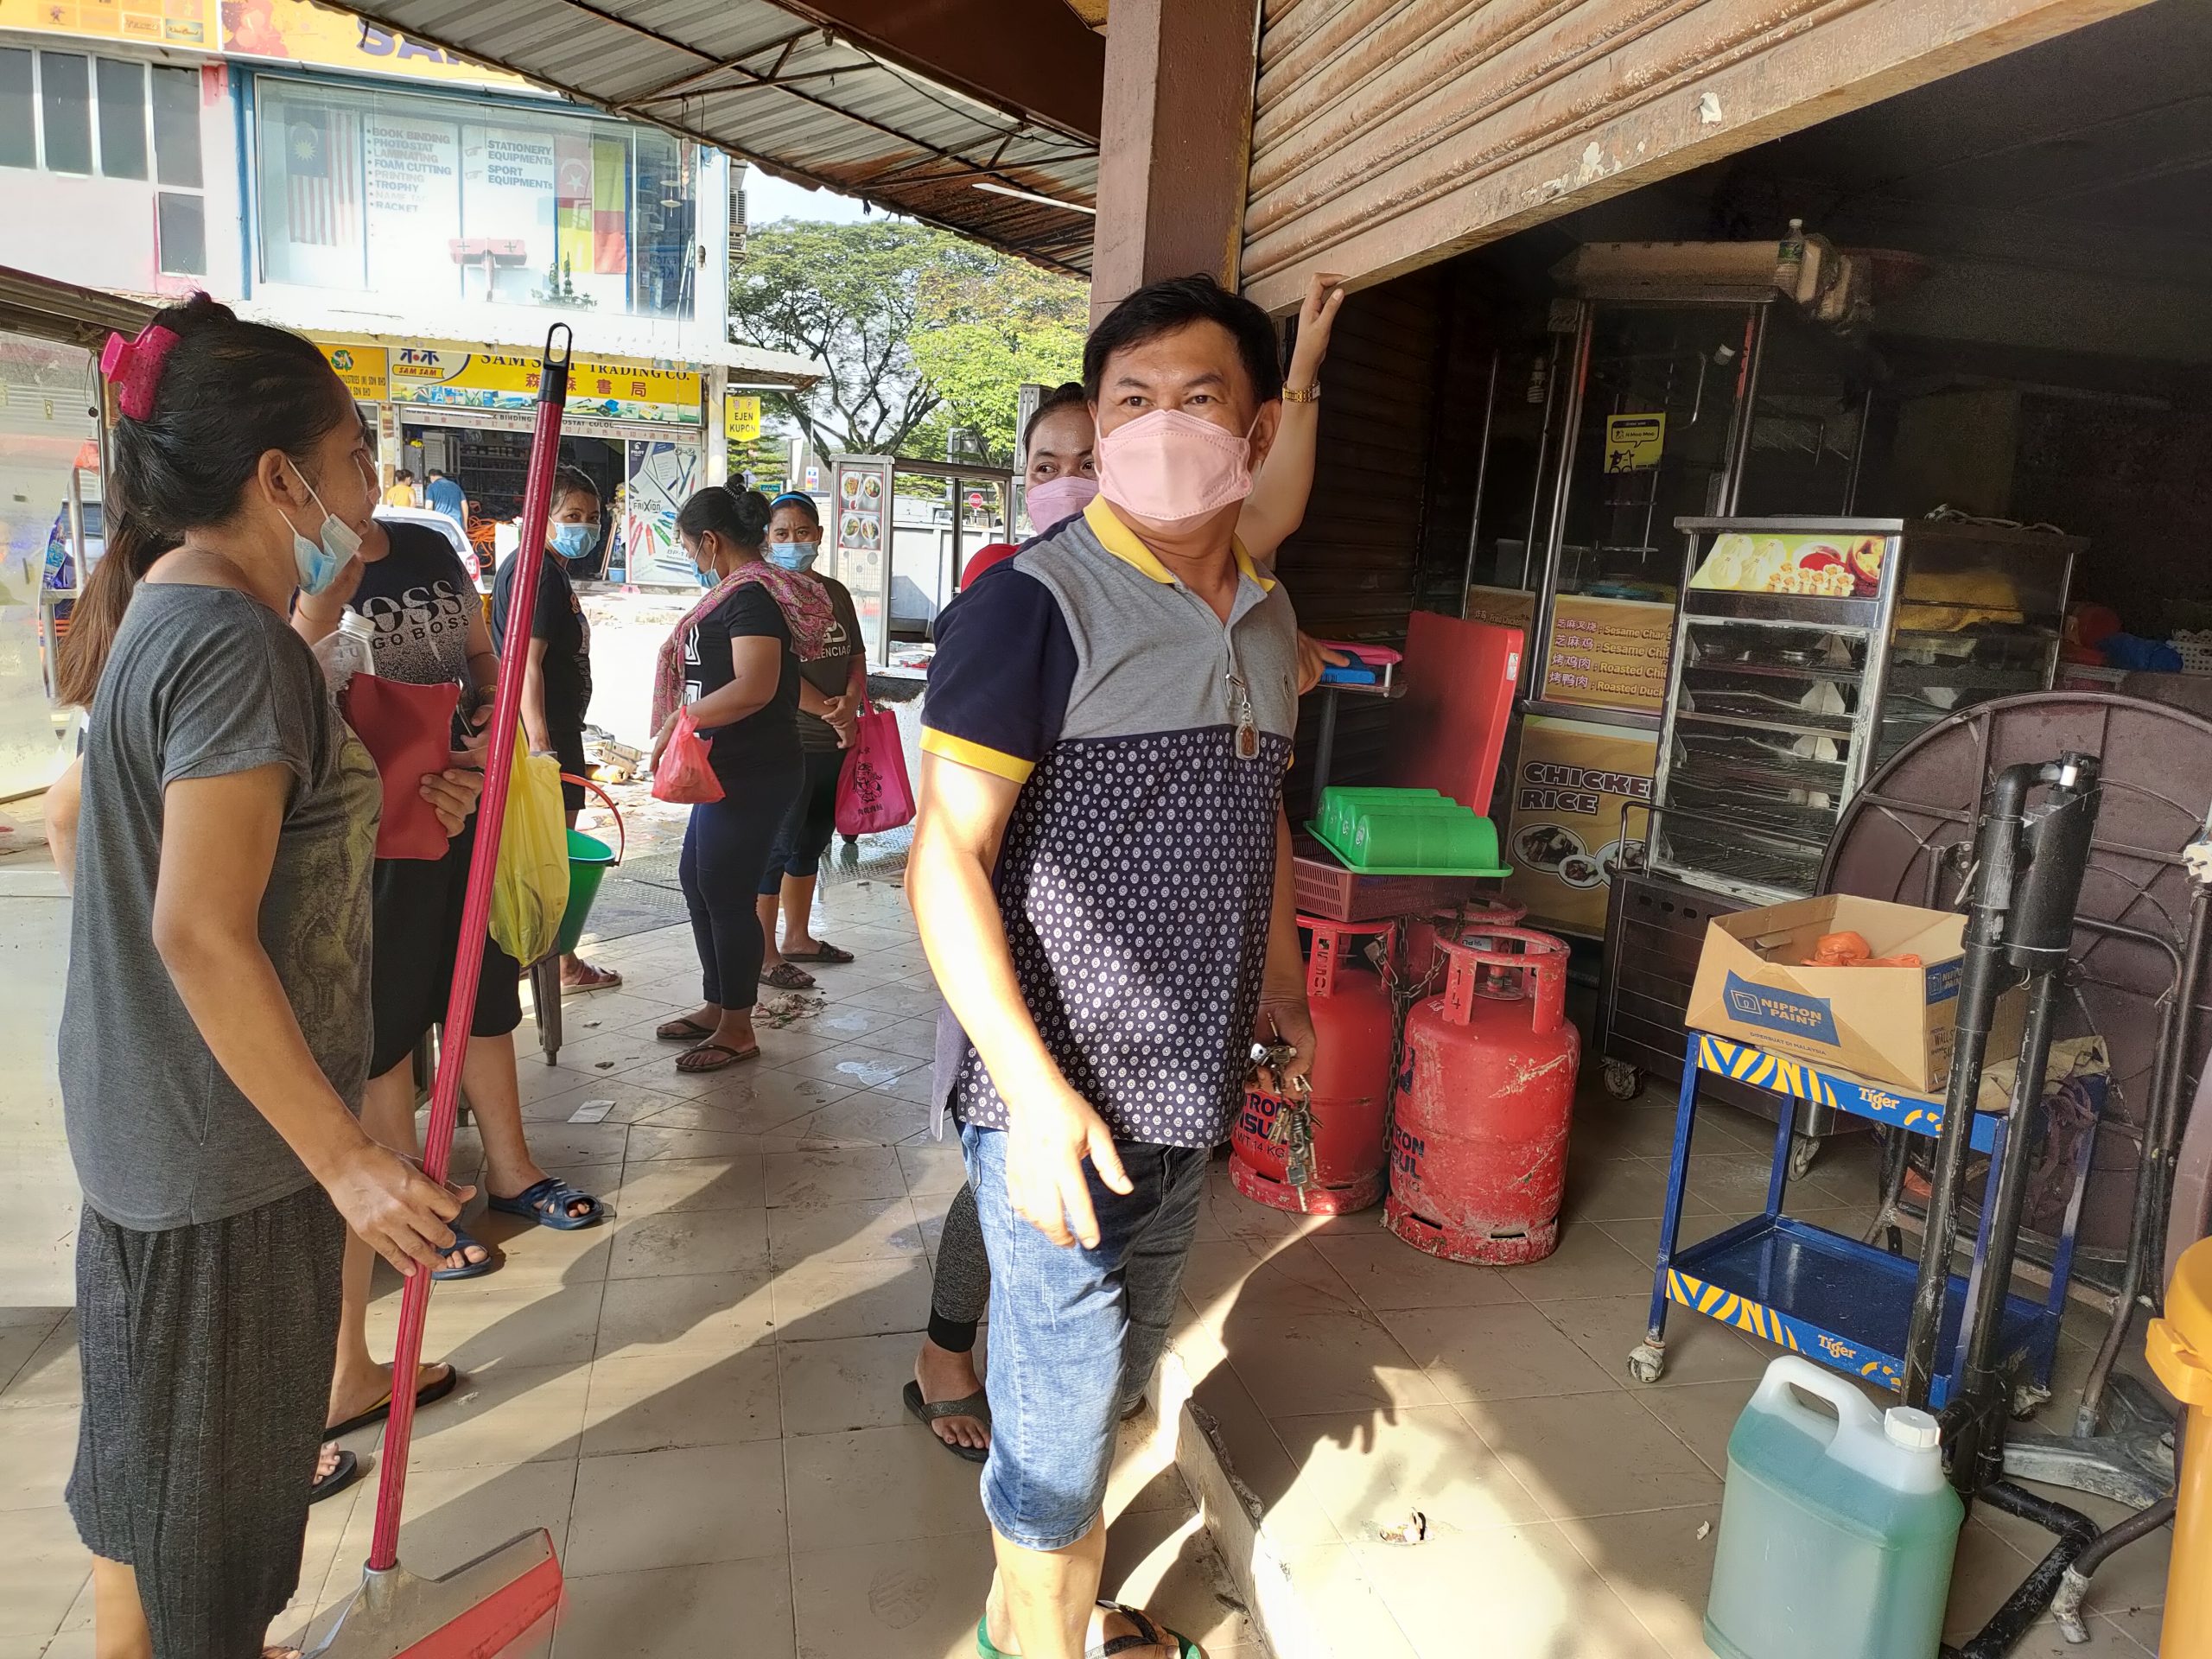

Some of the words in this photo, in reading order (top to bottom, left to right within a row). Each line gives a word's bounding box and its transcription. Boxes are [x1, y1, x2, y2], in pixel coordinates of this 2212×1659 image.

[372, 128, 404, 139] BOOK
[406, 130, 450, 144] BINDING
[373, 137, 434, 153] PHOTOSTAT
[487, 140, 551, 156] STATIONERY
[373, 148, 438, 164] LAMINATING
[374, 158, 404, 171] FOAM
[408, 162, 452, 175] CUTTING
[487, 164, 523, 176] SPORT
[374, 170, 424, 183] PRINTING
[375, 181, 419, 193] TROPHY
[376, 200, 418, 213] RACKET
[665, 371, 690, 381] CO.
[734, 412, 753, 421] EJEN
[729, 424, 756, 433] KUPON
[343, 581, 463, 632] OSS
[412, 614, 469, 640] BOSS
[1605, 626, 1640, 638] Sesame
[1643, 629, 1664, 640] Char
[1555, 635, 1593, 650] 芝麻鸡
[1603, 643, 1645, 656] Sesame
[1551, 653, 1591, 670] 烤鸡肉
[1600, 662, 1643, 676] Roasted
[1549, 671, 1589, 689] 烤鸭肉
[1598, 681, 1637, 695] Roasted
[1523, 761, 1653, 800] CHICKE
[1519, 788, 1599, 815] RICE
[1942, 967, 1963, 982] NIPPO
[1761, 998, 1821, 1020] NIPPON
[1770, 1008, 1818, 1027] PAINT
[1750, 1032, 1784, 1045] DIPERBUAT
[1794, 1042, 1827, 1056] MALAYSIA
[1859, 1087, 1900, 1111] Tiger
[1254, 1141, 1263, 1152] 14
[1268, 1146, 1285, 1158] KG
[1818, 1334, 1857, 1358] Tiger
